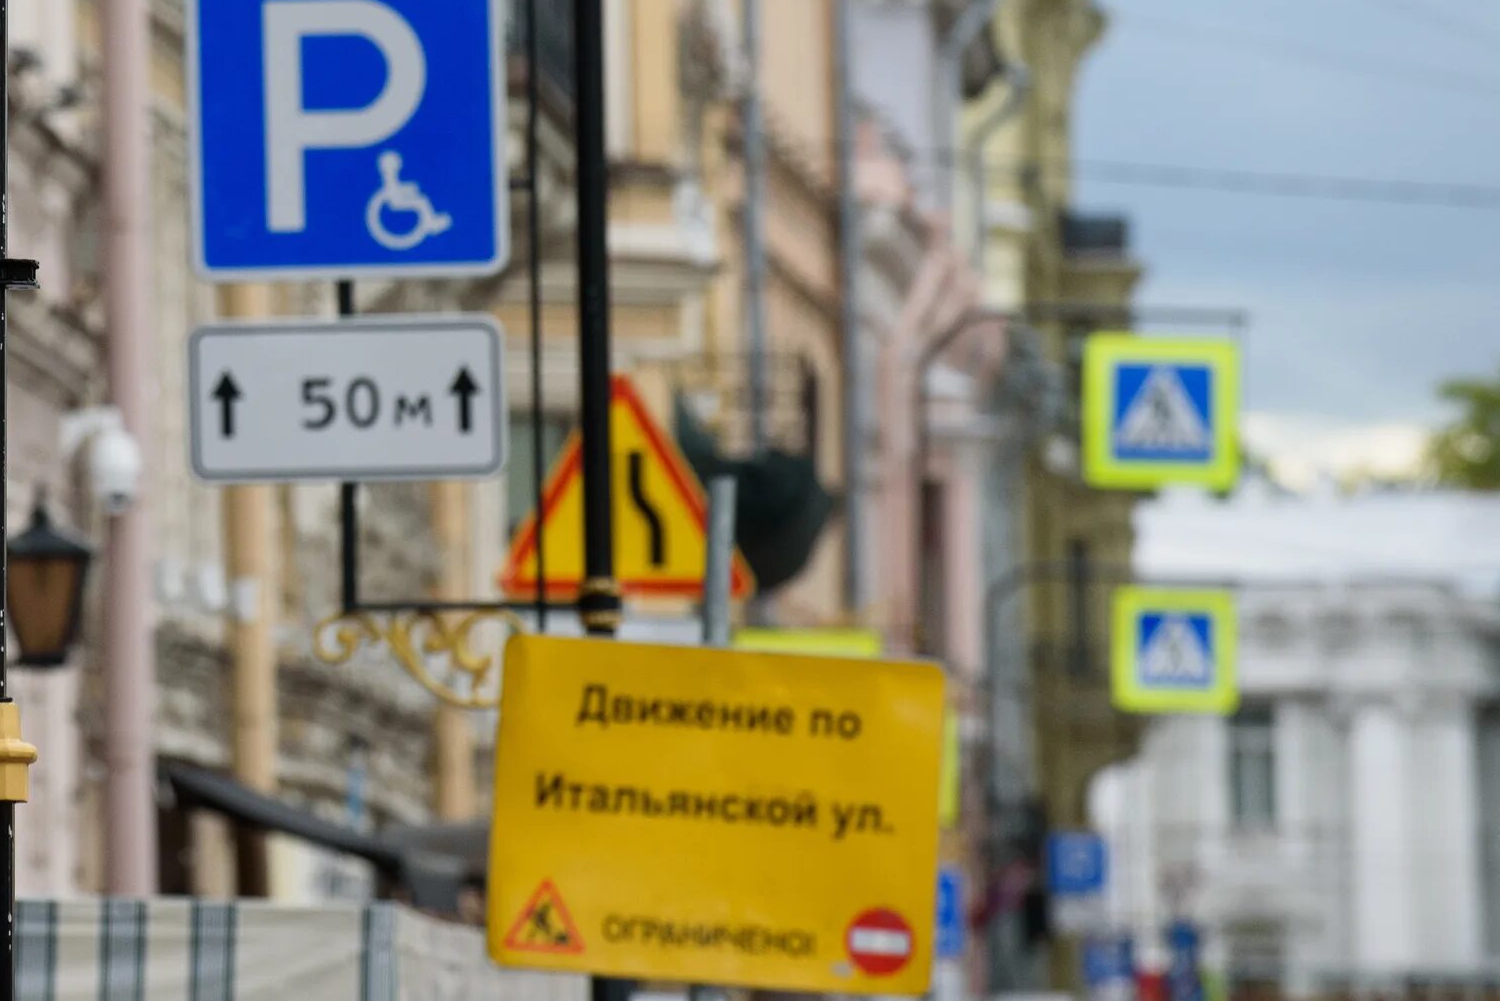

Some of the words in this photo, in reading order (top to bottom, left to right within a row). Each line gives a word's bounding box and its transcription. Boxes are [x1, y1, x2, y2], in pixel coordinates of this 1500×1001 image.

[300, 376, 380, 430] 50
[575, 682, 795, 736] Движение
[808, 707, 863, 740] по
[534, 770, 817, 829] Итальянской
[830, 799, 895, 841] ул.
